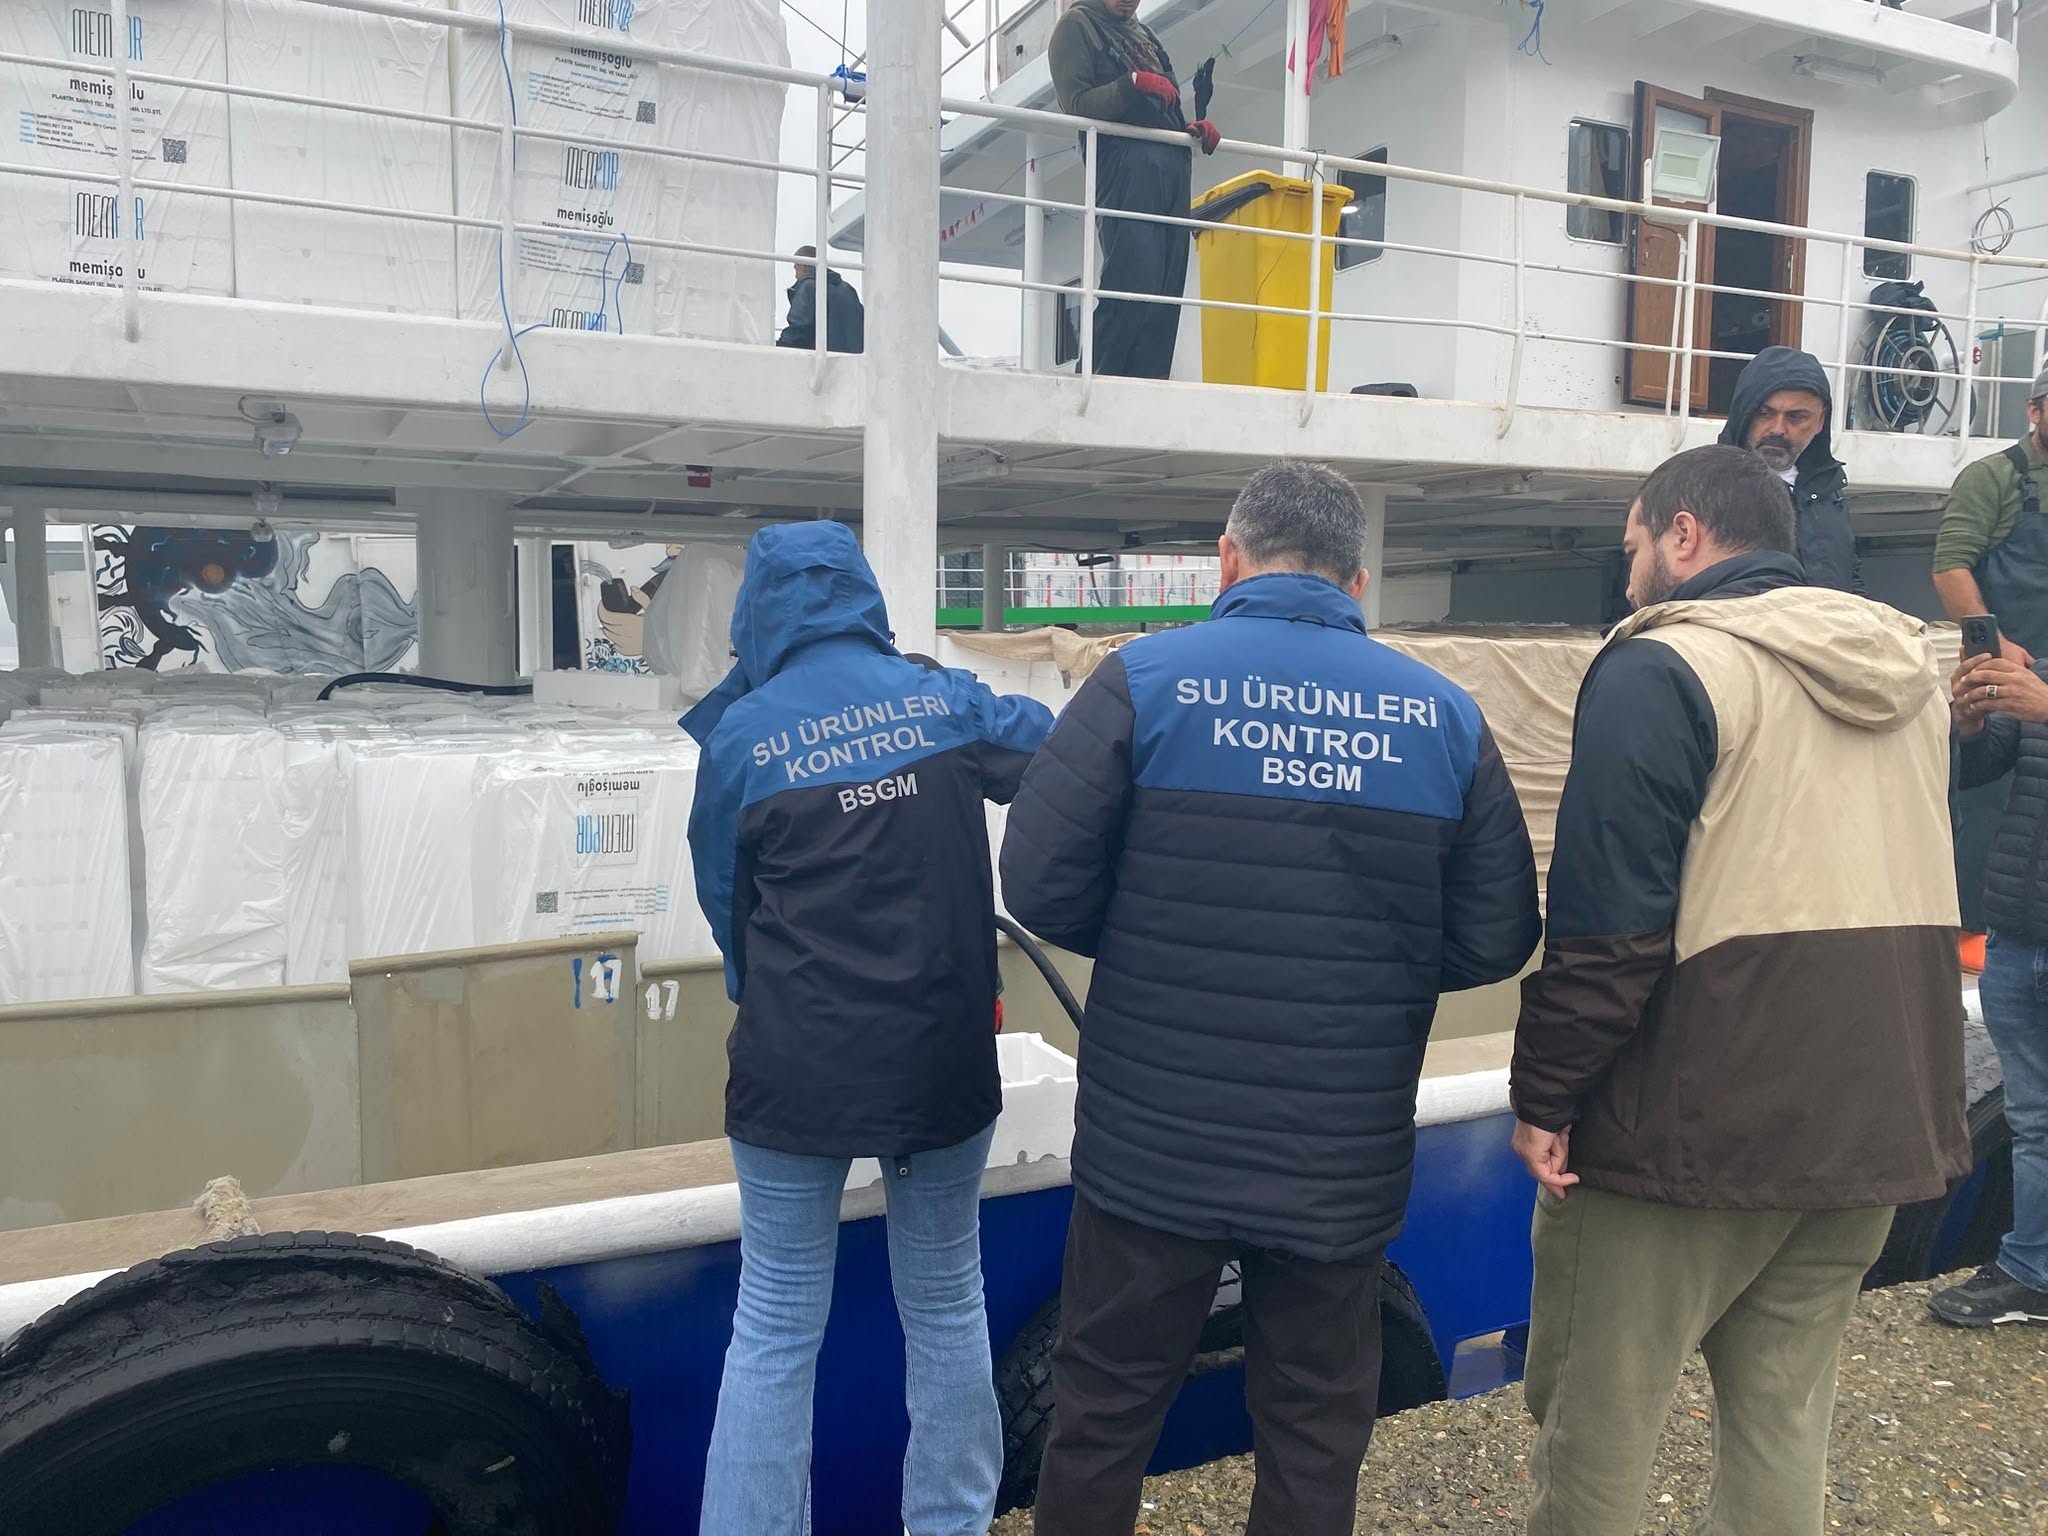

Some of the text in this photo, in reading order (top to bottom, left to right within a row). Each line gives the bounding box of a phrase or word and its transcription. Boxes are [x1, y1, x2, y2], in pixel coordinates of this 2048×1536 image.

[72, 8, 143, 61] MEMR
[69, 78, 144, 100] memişlu
[76, 192, 144, 240] MEMPR
[69, 259, 146, 280] memişou
[1176, 674, 1438, 728] SU ÜRÜNLERİ
[752, 693, 950, 767] SU ÜRÜNLERİ
[1213, 717, 1403, 763] KONTROL
[784, 725, 936, 783] KONTROL
[1262, 756, 1362, 792] BSGM
[837, 773, 918, 813] BSGM
[576, 813, 634, 854] MEMPOR
[645, 979, 680, 1021] 17
